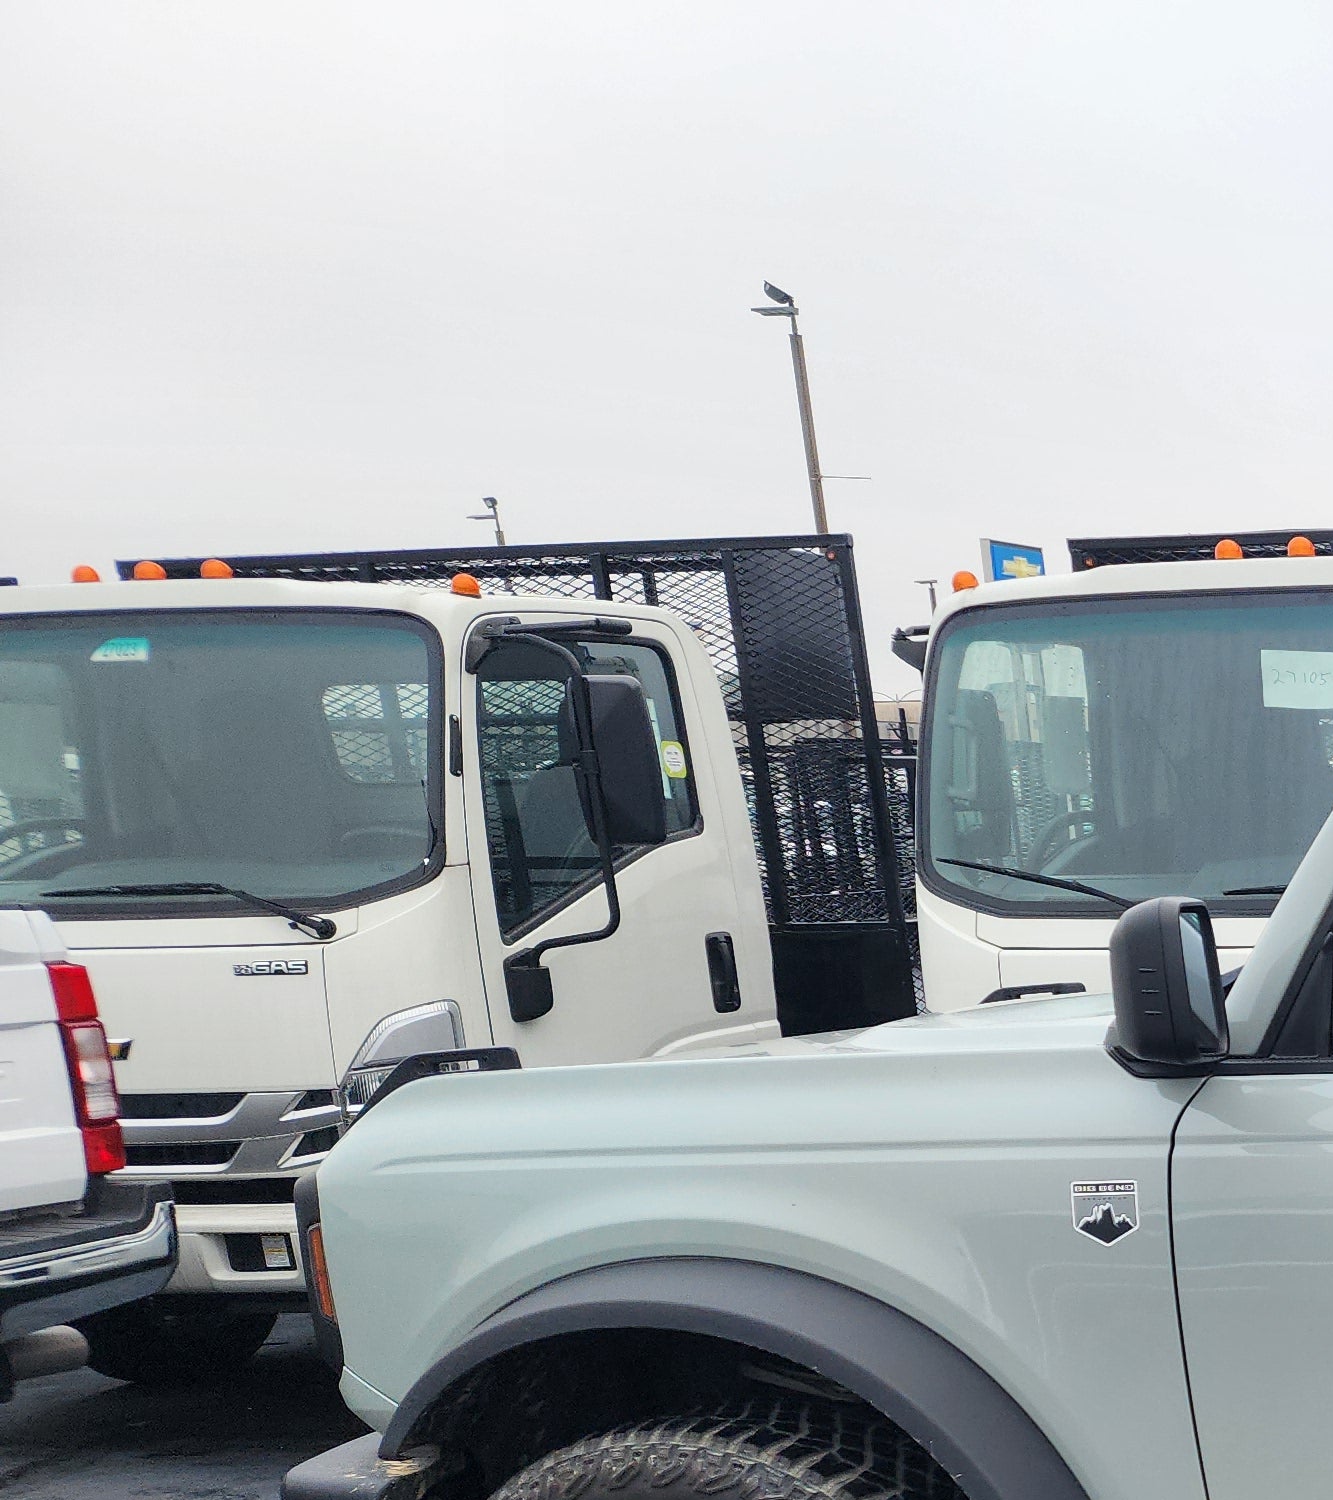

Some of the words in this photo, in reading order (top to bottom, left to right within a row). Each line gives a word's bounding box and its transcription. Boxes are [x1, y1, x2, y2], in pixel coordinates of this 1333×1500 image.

[1271, 668, 1332, 686] 27105
[251, 960, 307, 974] GAS
[1074, 1185, 1097, 1193] BIG
[1098, 1184, 1134, 1192] BEND
